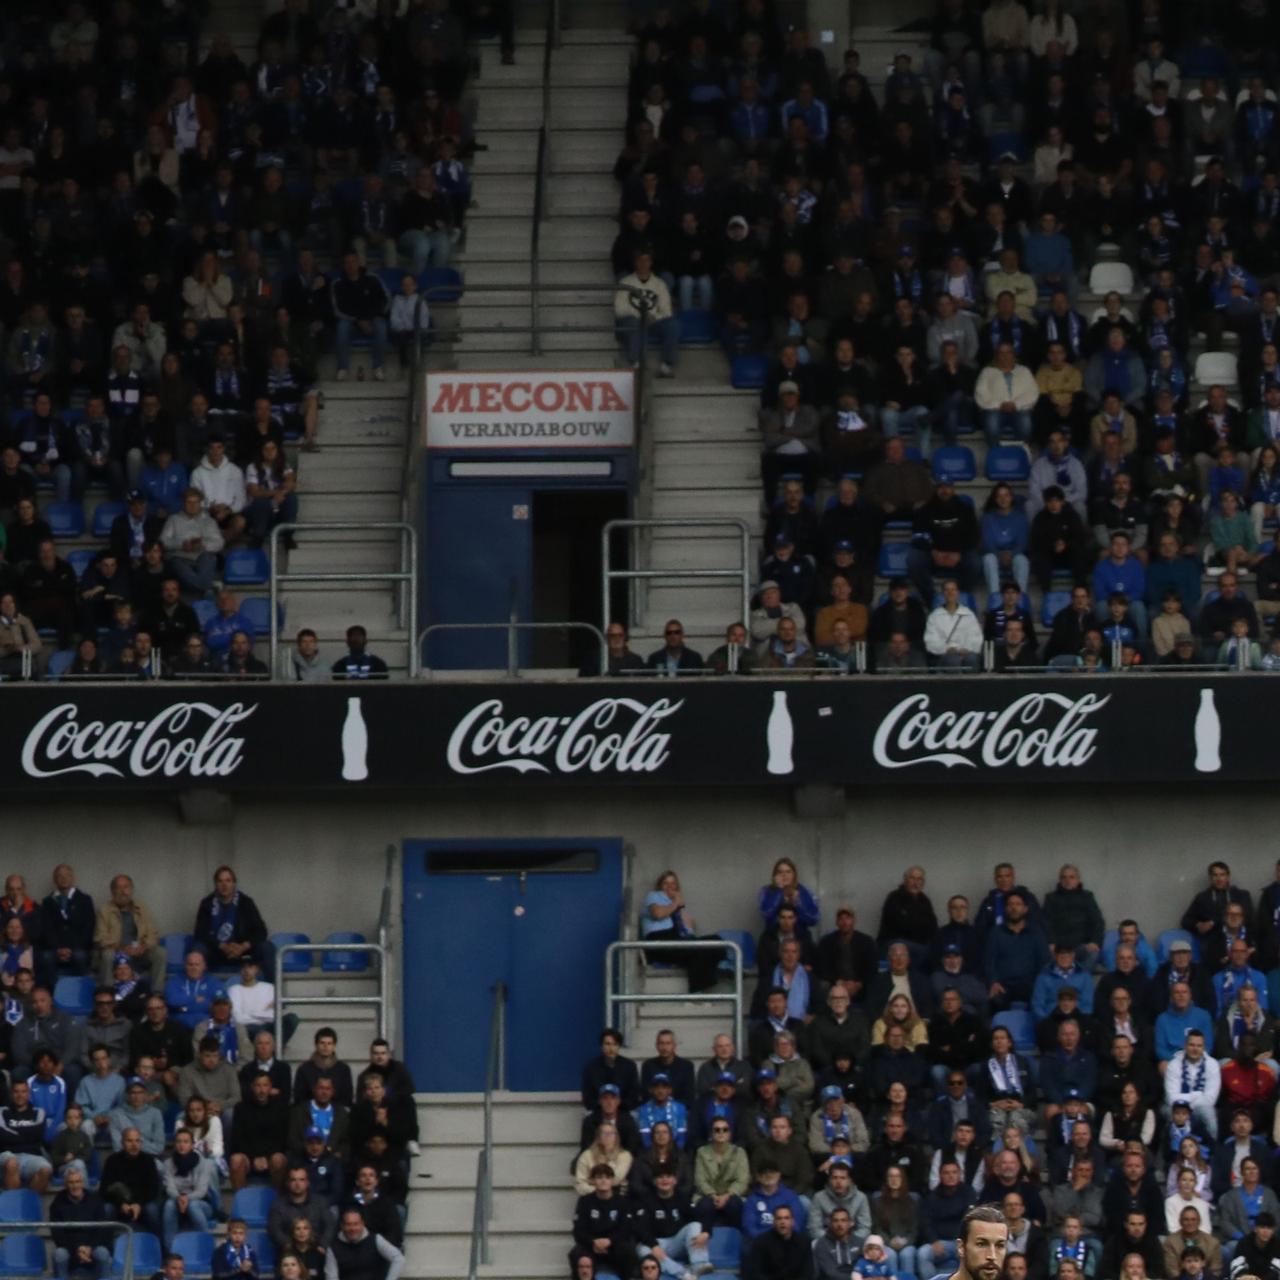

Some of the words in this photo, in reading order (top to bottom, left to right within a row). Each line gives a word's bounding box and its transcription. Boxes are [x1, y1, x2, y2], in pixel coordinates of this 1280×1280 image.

[431, 381, 630, 413] MECONA
[449, 422, 611, 438] VERANDABOUW
[22, 703, 256, 777] Coca-Cola
[448, 699, 683, 773] Coca-Cola
[874, 693, 1109, 767] Coca-Cola
